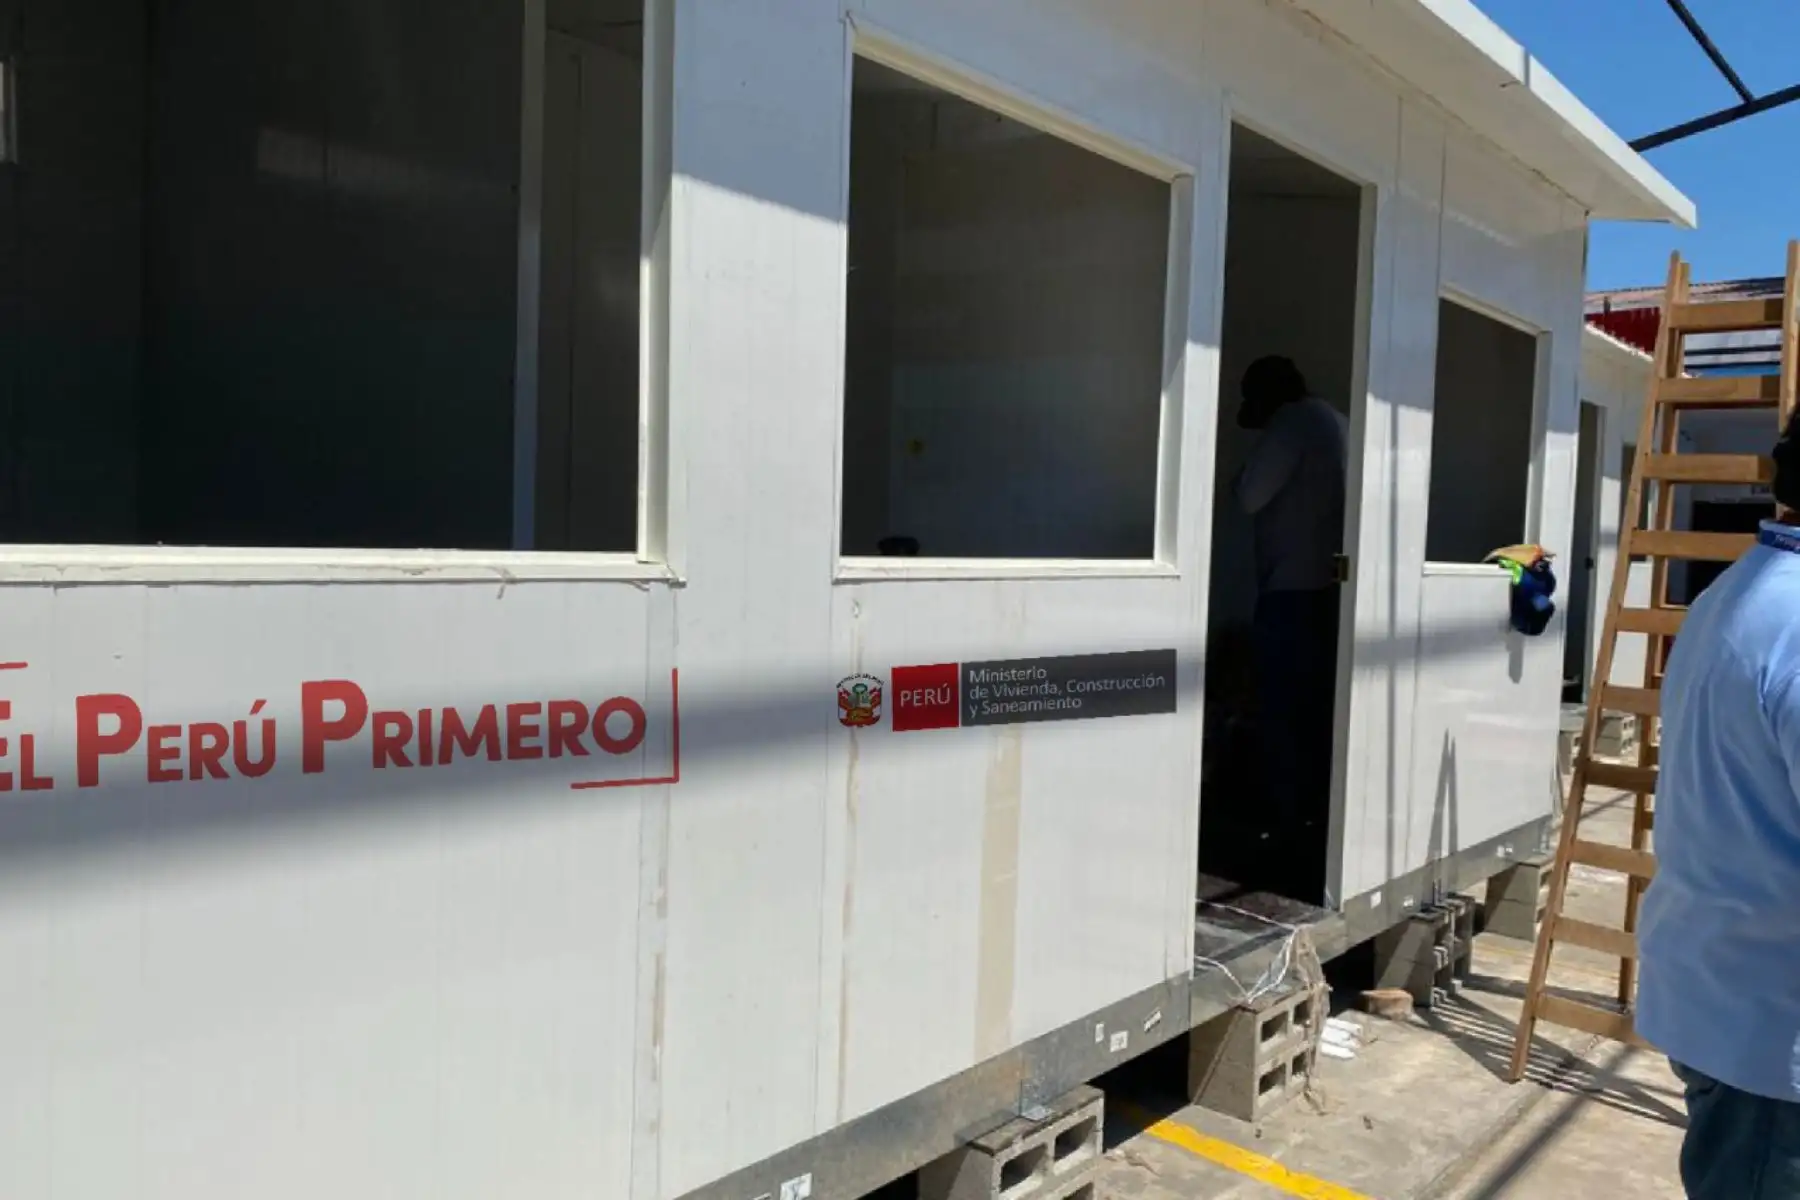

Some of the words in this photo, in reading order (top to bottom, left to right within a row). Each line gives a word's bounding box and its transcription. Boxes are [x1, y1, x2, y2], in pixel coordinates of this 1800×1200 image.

[969, 666, 1047, 683] Ministerio
[969, 685, 989, 699] de
[992, 680, 1062, 698] Vivienda,
[1066, 672, 1166, 693] Construcción
[900, 683, 951, 707] PERÚ
[969, 703, 979, 719] y
[981, 696, 1083, 715] Saneamiento
[0, 700, 54, 791] L
[76, 693, 276, 788] PERÚ
[301, 679, 645, 772] PRIMERO
